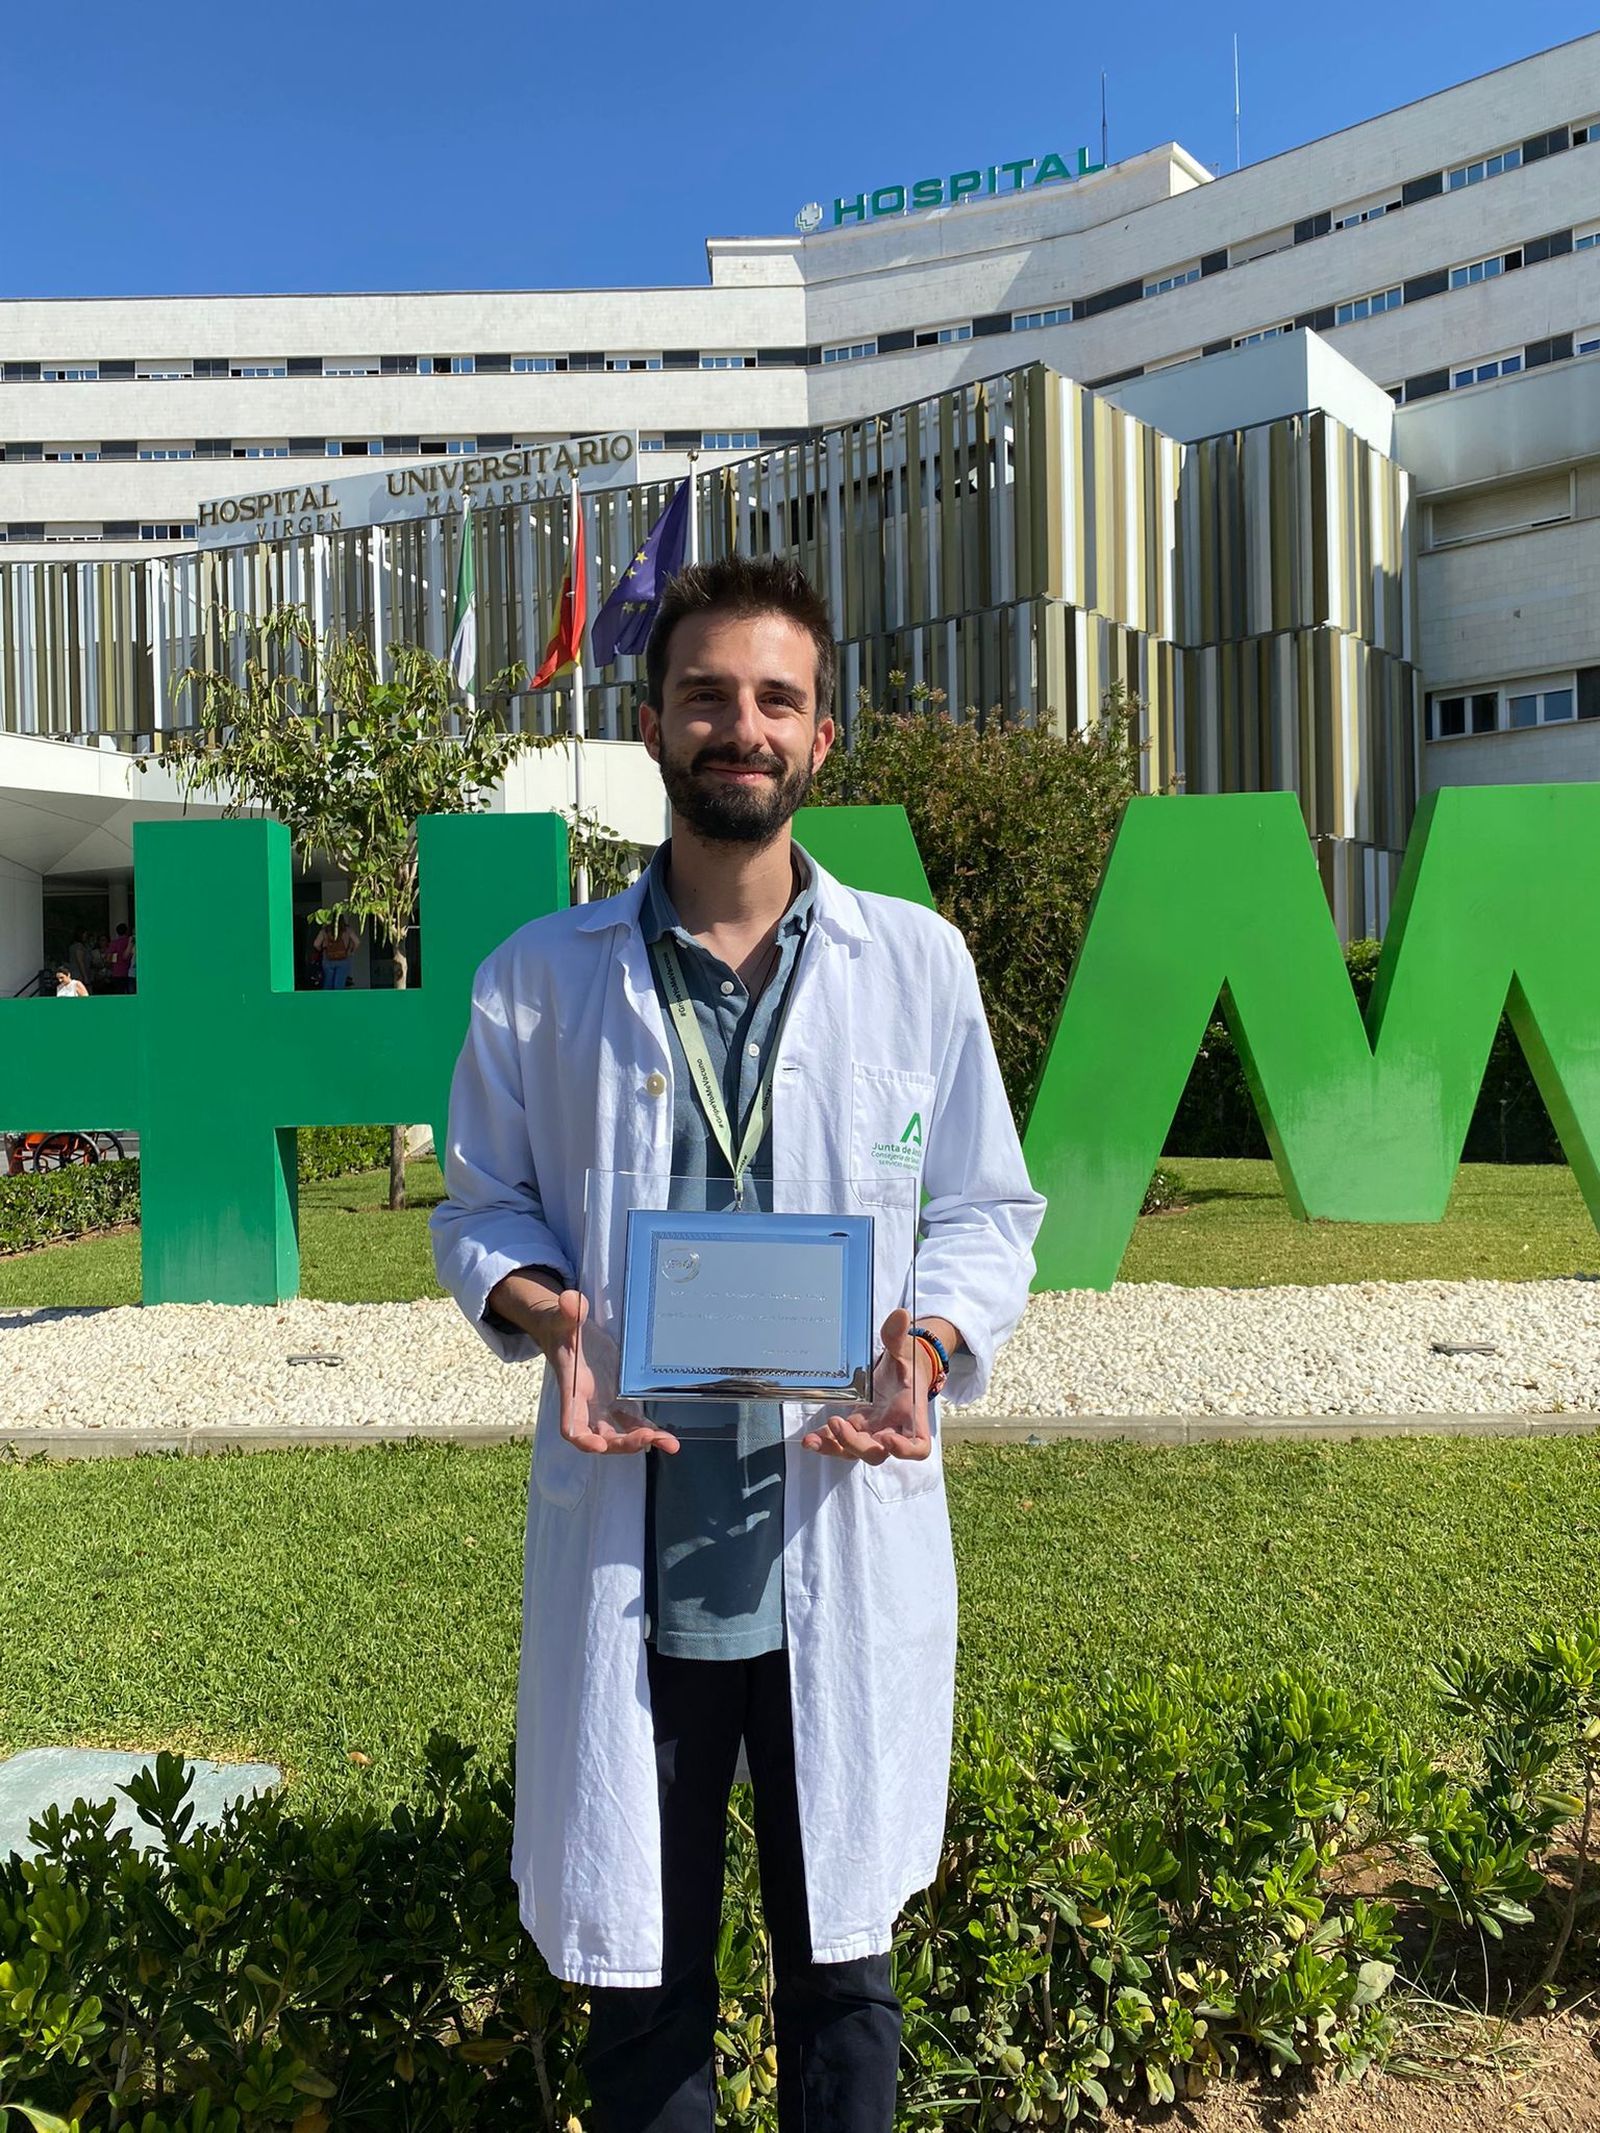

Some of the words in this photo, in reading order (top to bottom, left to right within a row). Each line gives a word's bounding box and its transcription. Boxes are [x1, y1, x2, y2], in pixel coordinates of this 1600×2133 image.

[834, 146, 1106, 226] HOSPITAL
[198, 484, 338, 527] HOSPITAL
[386, 435, 633, 497] UNIVERSITARIO
[256, 511, 342, 540] VIRGEN
[696, 1058, 725, 1129] #GripeYoMeVacuno
[871, 1142, 901, 1153] Junta
[901, 1145, 912, 1155] de
